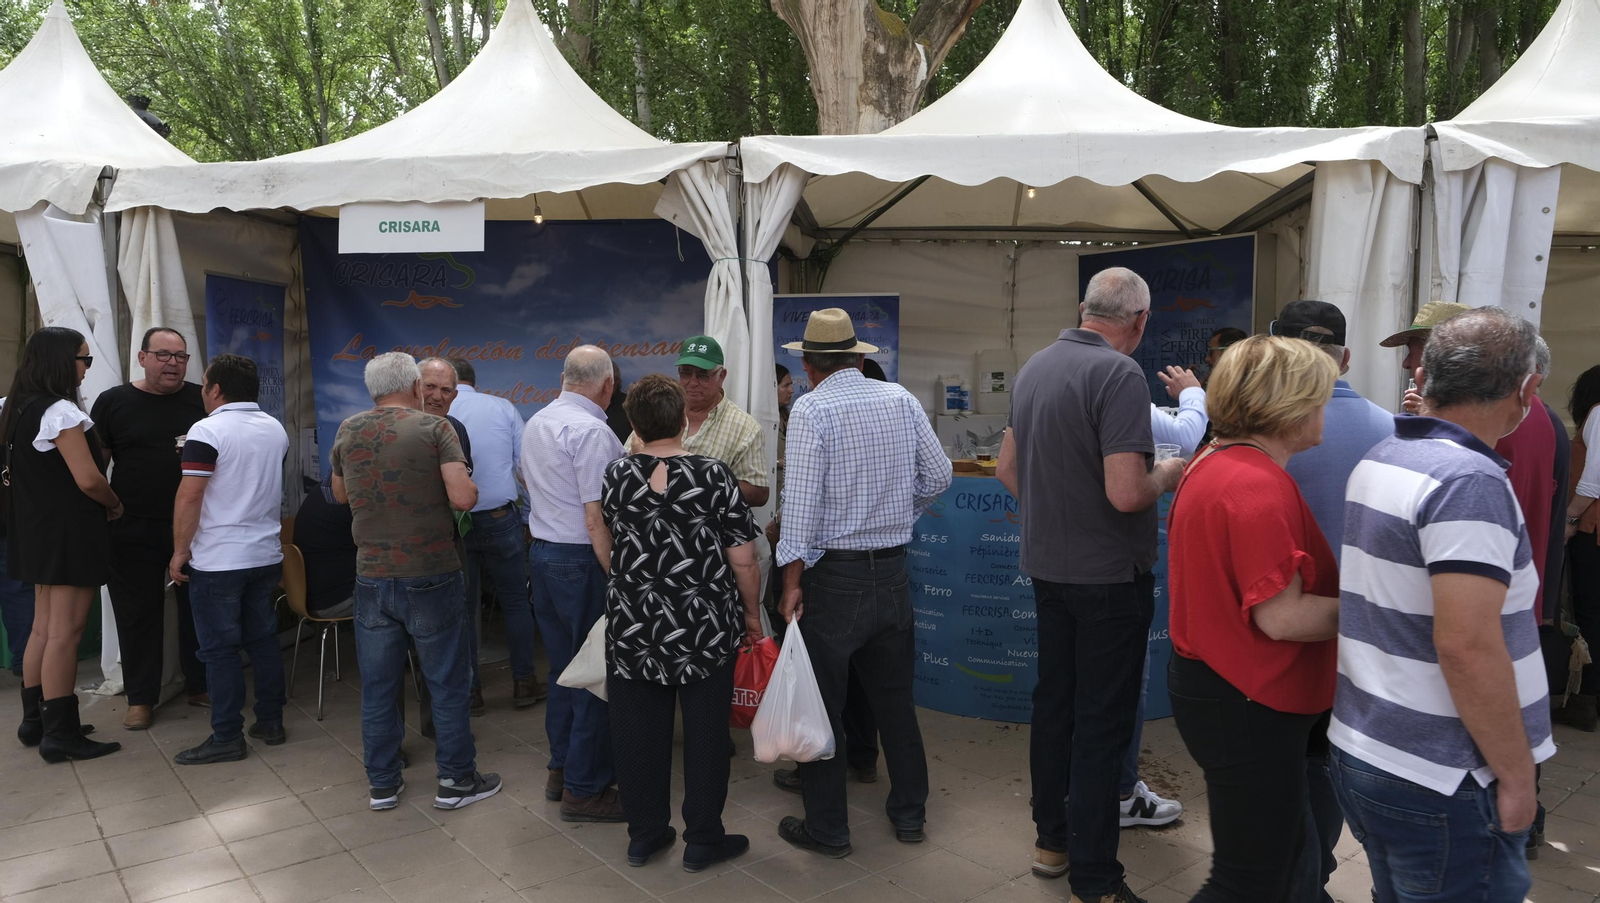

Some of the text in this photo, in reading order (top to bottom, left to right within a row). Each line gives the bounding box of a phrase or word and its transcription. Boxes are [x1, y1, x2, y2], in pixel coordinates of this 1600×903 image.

[378, 220, 441, 233] CRISARA
[333, 260, 448, 289] CRISARA
[1143, 265, 1211, 293] CRISA
[229, 308, 273, 329] FERCRISA
[783, 311, 811, 323] VIVE
[776, 335, 804, 344] Produ
[332, 332, 376, 361] La
[393, 336, 524, 361] evolución
[535, 336, 582, 360] del
[1175, 353, 1208, 365] NITR
[920, 533, 949, 544] 5-5-5
[980, 532, 1020, 543] Sanida
[969, 546, 1020, 559] Pépinière
[912, 565, 947, 576] nurseries
[990, 562, 1020, 571] Comerci
[965, 573, 1011, 586] FERCRISA
[924, 584, 953, 597] Ferro
[962, 604, 1010, 619] FERCRISA
[914, 620, 937, 631] Activa
[1148, 628, 1169, 641] lus
[965, 638, 1003, 650] Technique
[922, 652, 950, 667] Plus
[1007, 649, 1039, 659] Nuevo
[967, 655, 1029, 668] Communication
